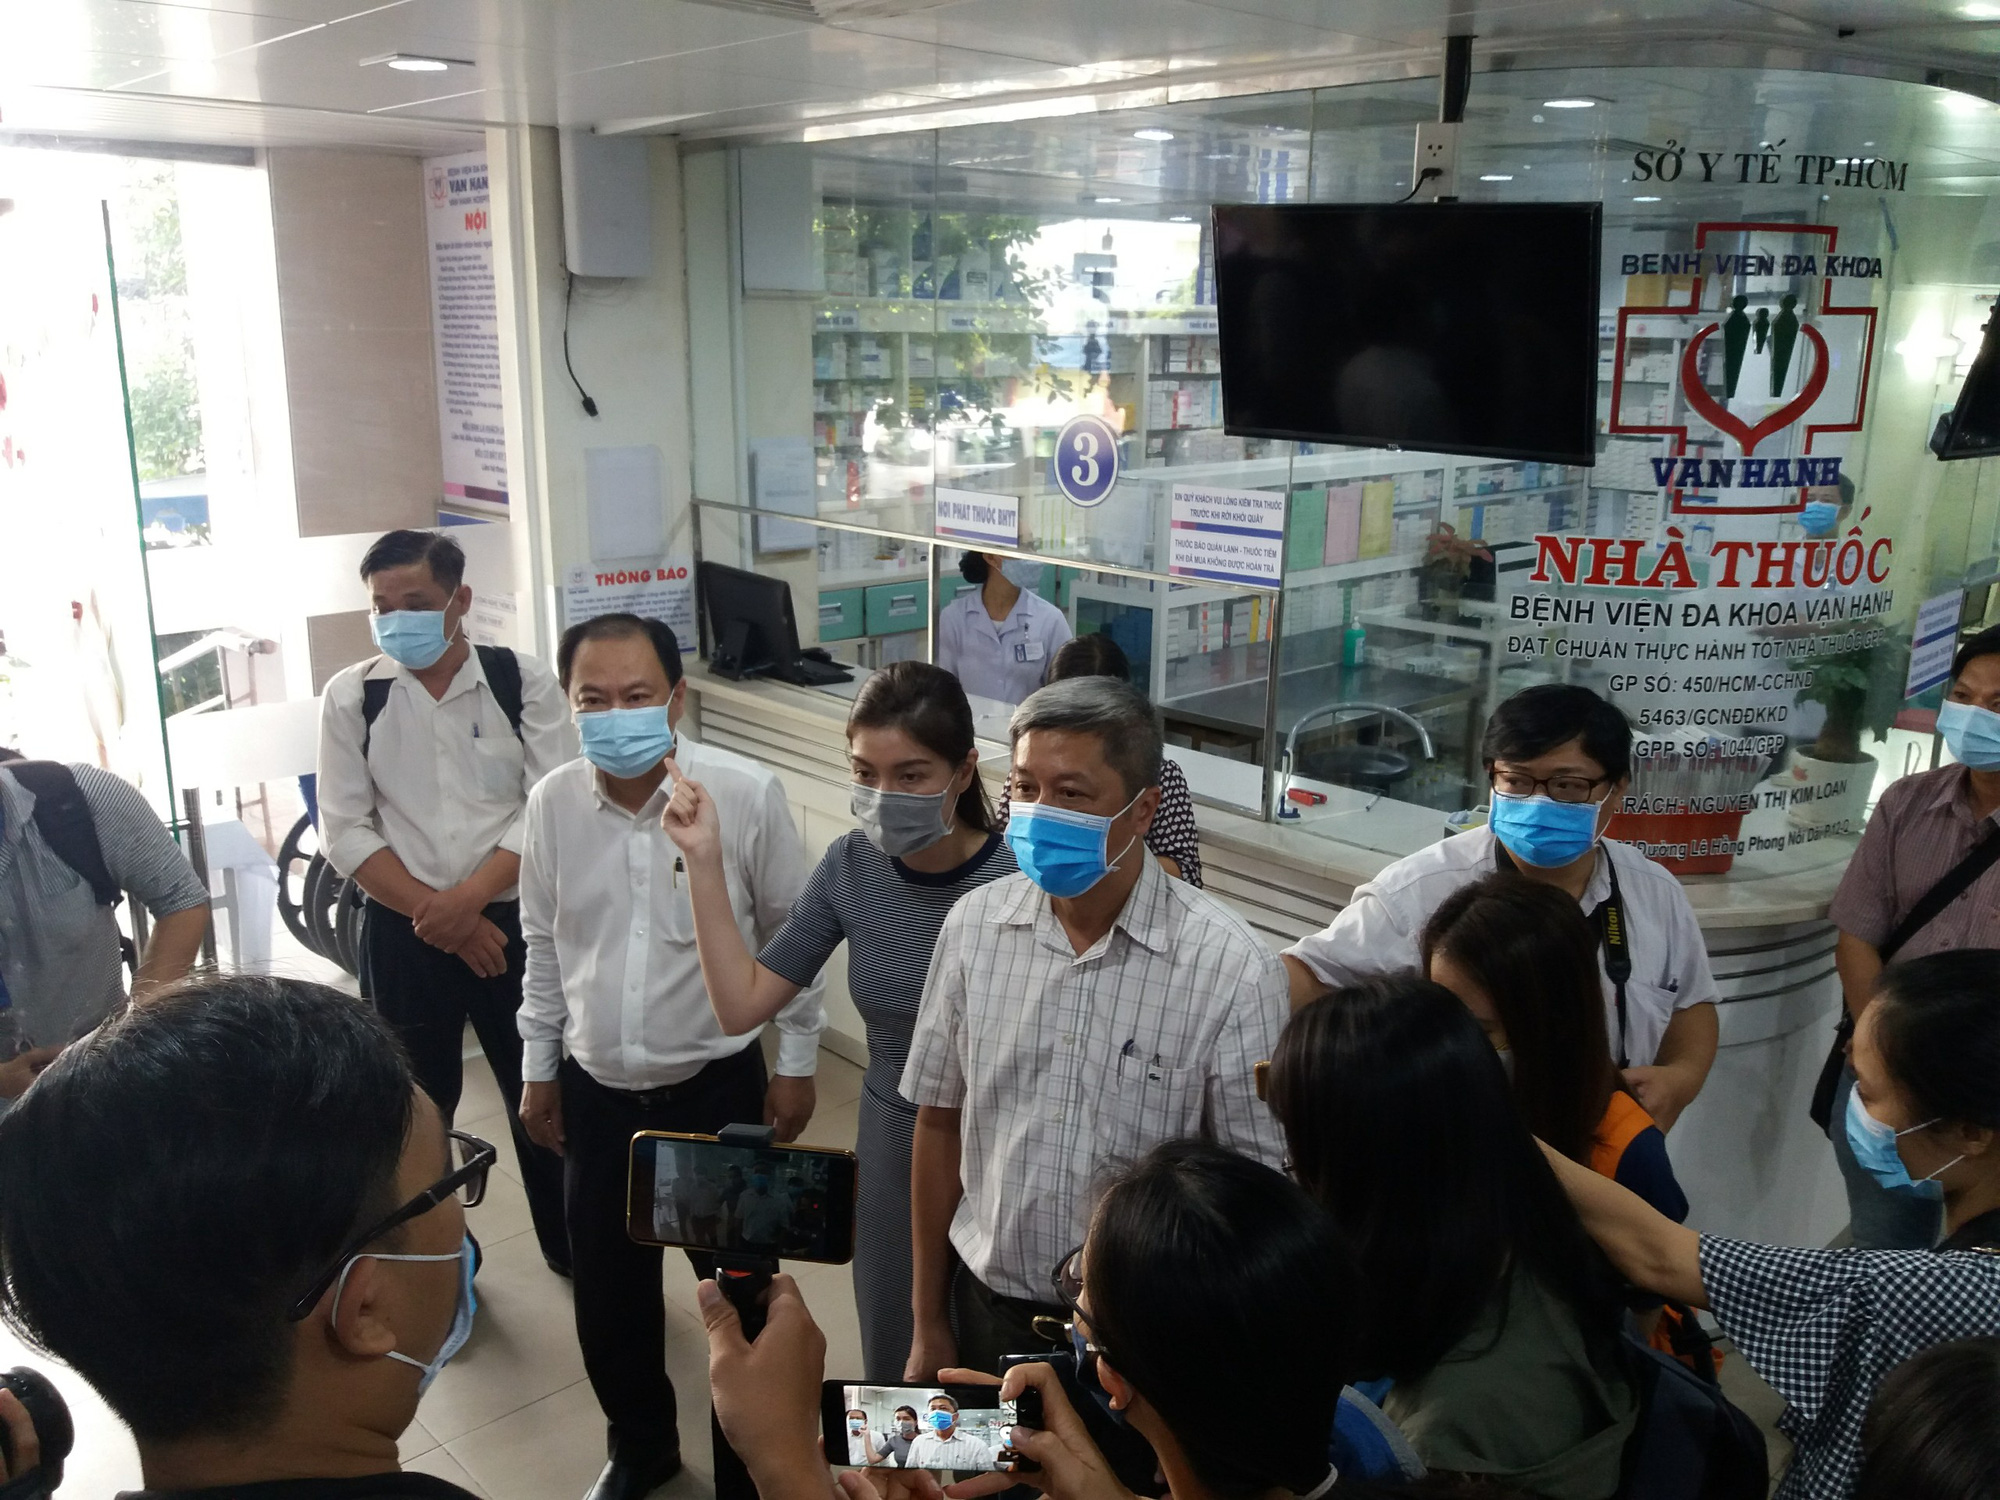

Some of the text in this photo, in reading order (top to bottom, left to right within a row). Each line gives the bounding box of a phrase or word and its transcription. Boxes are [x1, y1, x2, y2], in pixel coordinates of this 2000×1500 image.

[1631, 138, 1909, 193] SỞ Y TẾ TP.HCM
[1784, 254, 1817, 276] ĐA
[1825, 255, 1883, 279] KHOA
[1071, 432, 1100, 487] 3
[1528, 505, 1893, 589] NHÀ THUỐC
[595, 564, 688, 587] THÔNG BÁO
[1510, 593, 1595, 628] BỆNH
[1605, 598, 1673, 633] VIỆN
[1681, 603, 1721, 628] ĐA
[1728, 601, 1798, 627] KHOA
[1806, 596, 1845, 628] VẠN
[1849, 590, 1894, 623] HẠNH
[1507, 636, 1550, 660] ĐẠT
[1634, 642, 1690, 665] THỰC
[1695, 639, 1746, 661] HÀNH
[1609, 674, 1638, 692] GP
[1682, 670, 1815, 693] 450/HCM-CCHND
[1638, 705, 1788, 726] 5463/GCNĐĐKKD
[1635, 740, 1675, 758] GPP
[1720, 735, 1785, 757] 1044/GPP
[1614, 791, 1684, 815] RÁCH:
[1764, 791, 1787, 811] THỊ
[1789, 786, 1814, 805] KIM
[1816, 779, 1848, 801] LOAN
[1690, 838, 1708, 857] Lê
[1710, 835, 1745, 856] Hồng
[1748, 836, 1786, 852] Phong
